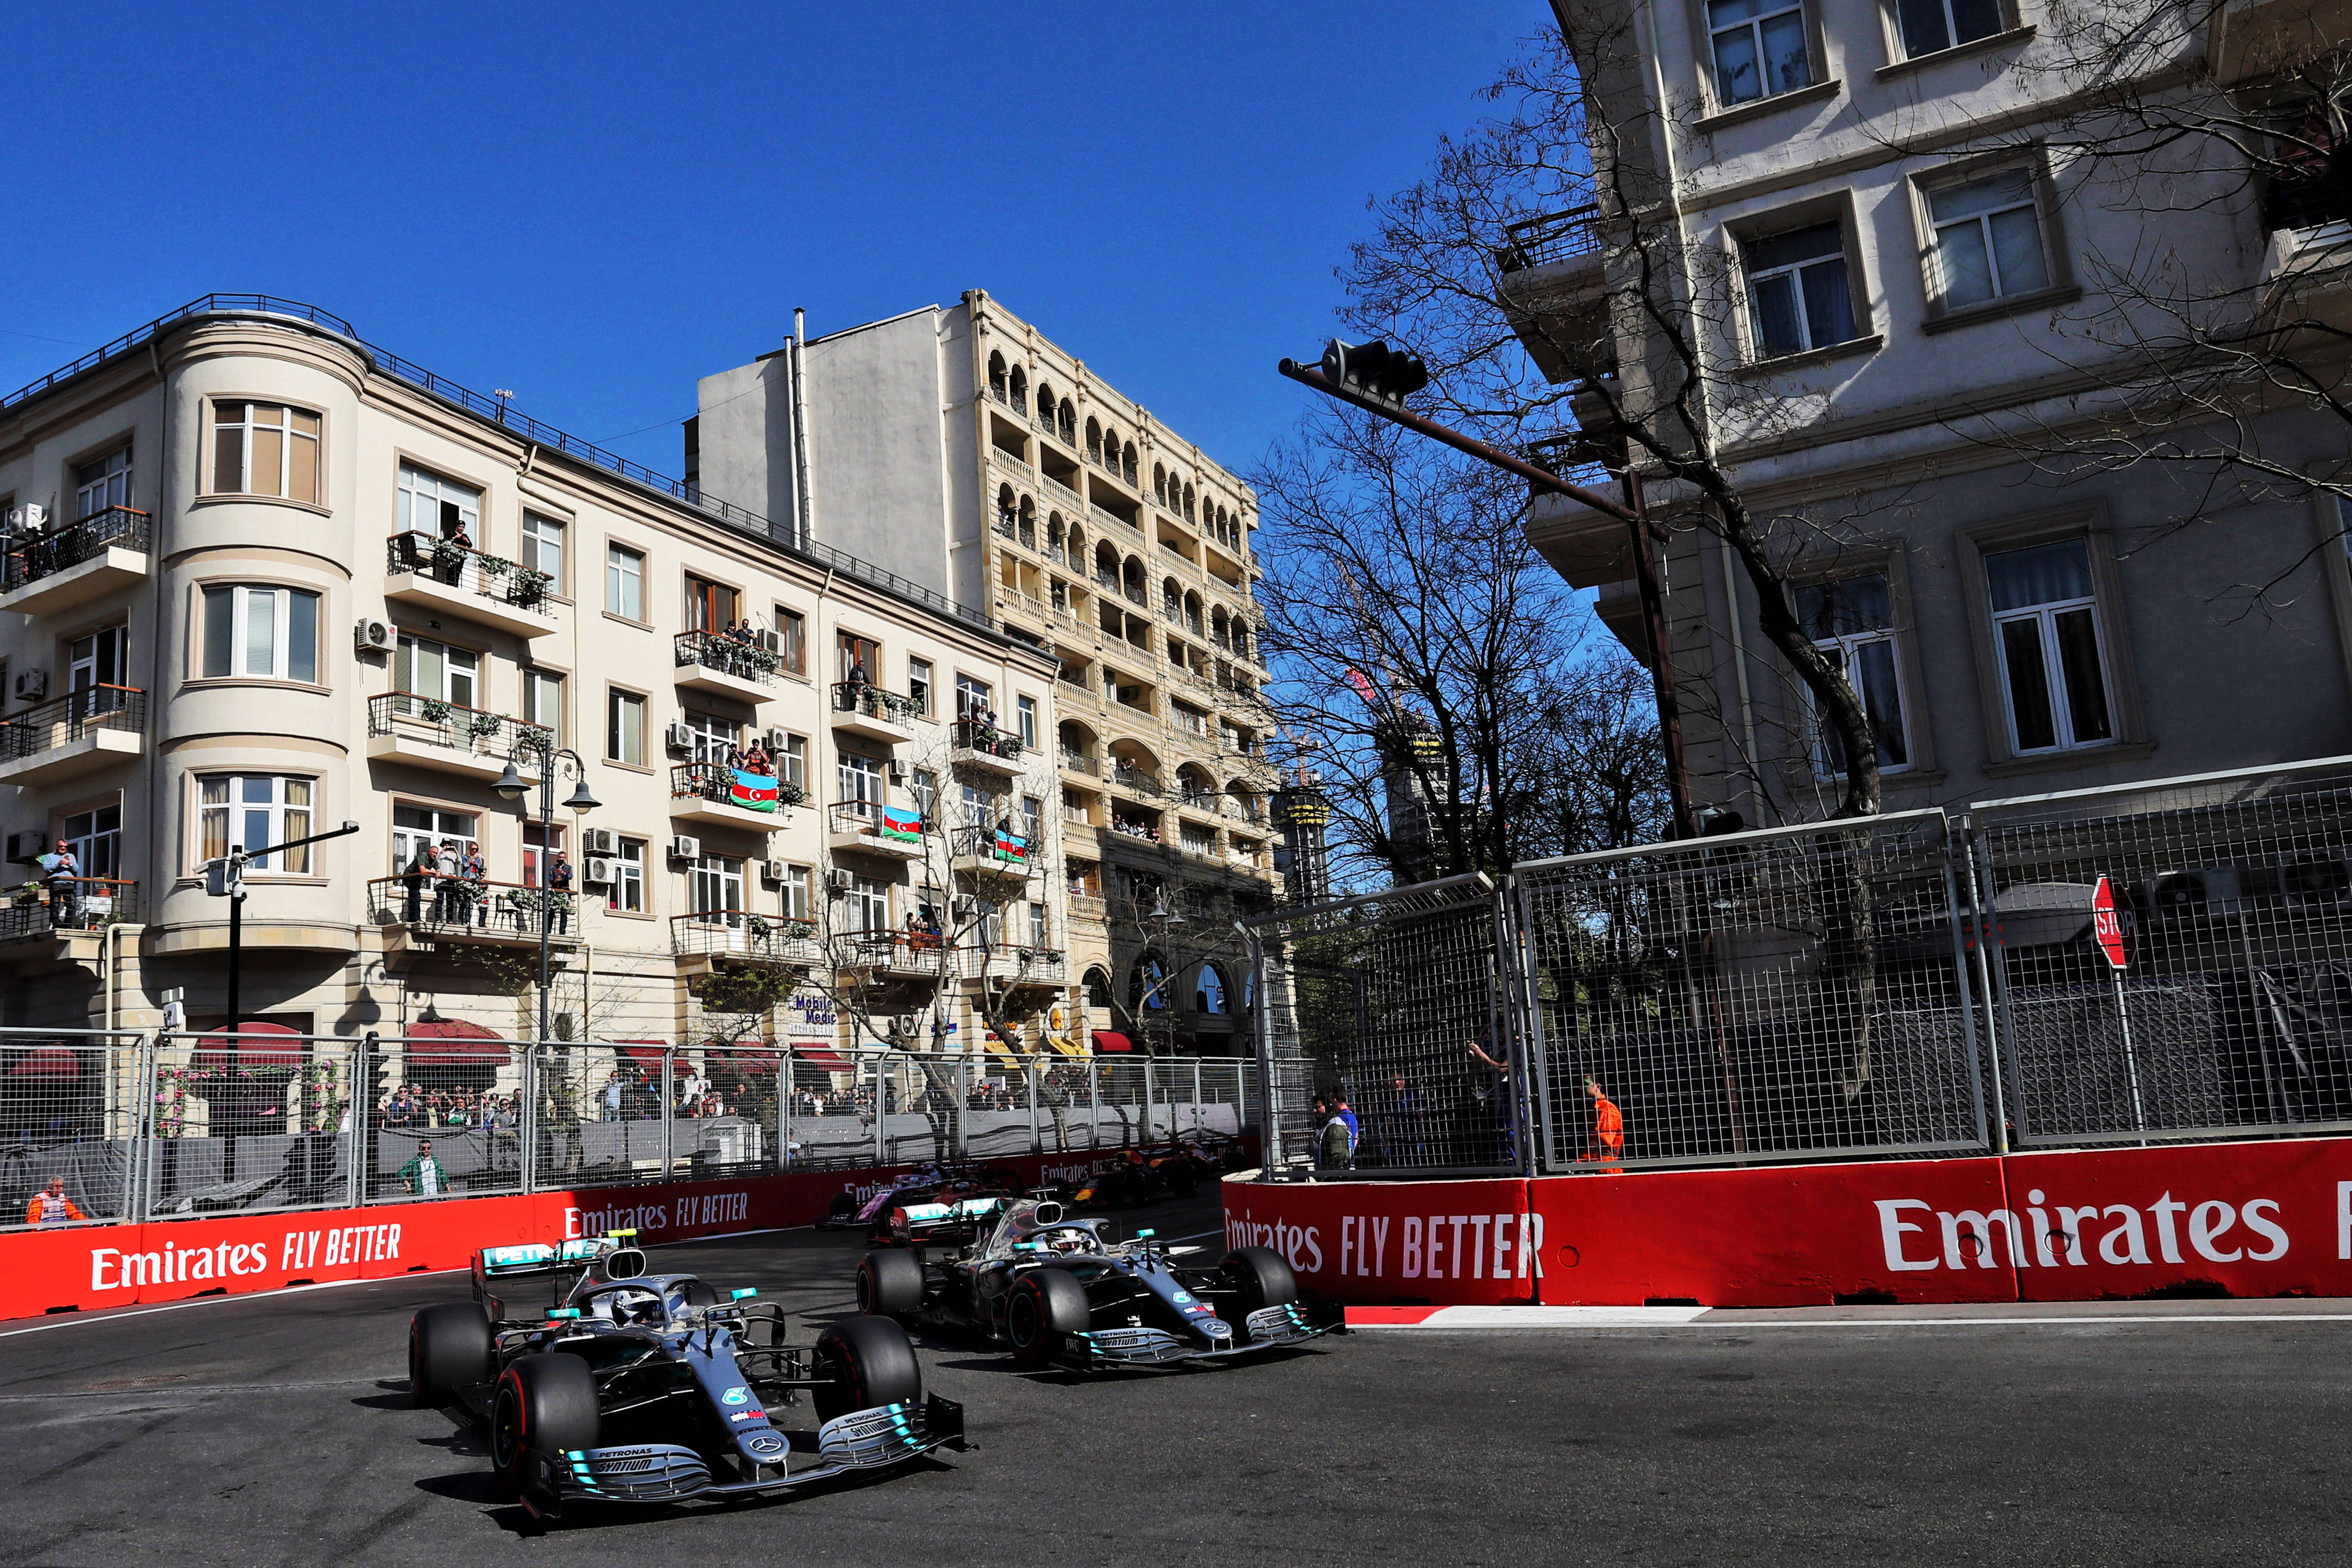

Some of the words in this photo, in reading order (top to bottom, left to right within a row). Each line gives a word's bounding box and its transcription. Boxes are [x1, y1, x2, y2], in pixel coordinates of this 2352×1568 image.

[2098, 906, 2132, 936] STOP
[796, 995, 833, 1010] Mobile
[806, 1010, 836, 1023] Medic
[1041, 1162, 1089, 1185] Emirates
[564, 1203, 667, 1239] Emirates
[676, 1197, 698, 1227] FLY
[702, 1192, 747, 1224] BETTER
[1874, 1189, 2289, 1271] Emirates
[1341, 1216, 1389, 1277] FLY
[1403, 1213, 1544, 1279] BETTER
[91, 1241, 267, 1291] Emirates
[282, 1231, 319, 1271] FLY
[325, 1223, 401, 1266] BETTER
[1066, 1338, 1079, 1351] IWC
[1102, 1338, 1139, 1346] SYNTIUM
[844, 1412, 882, 1424] PETRONAS
[850, 1421, 890, 1437] SYNTIUM
[599, 1448, 652, 1458] PETRONAS
[597, 1459, 652, 1472] SYNTIUM
